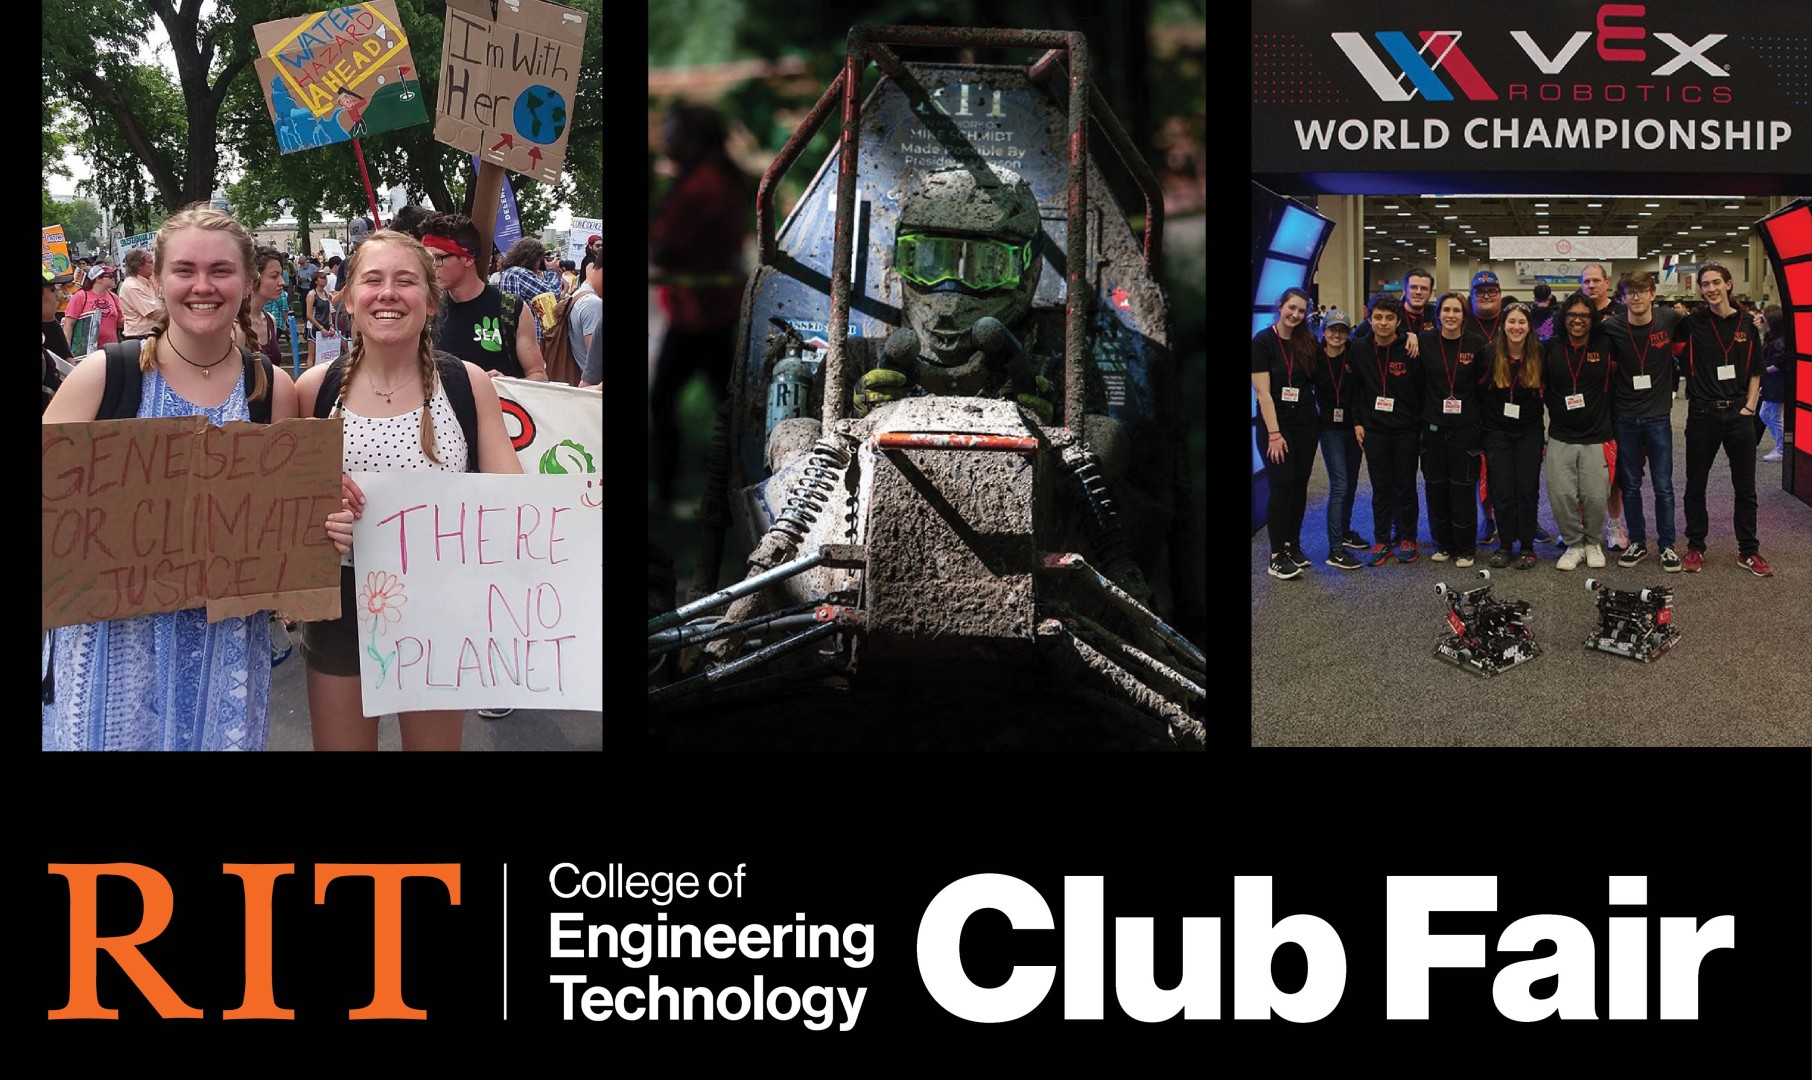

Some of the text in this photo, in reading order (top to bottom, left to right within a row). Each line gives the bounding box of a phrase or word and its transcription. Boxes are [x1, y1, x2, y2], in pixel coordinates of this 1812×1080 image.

[293, 12, 374, 88] HAZARD
[451, 10, 568, 82] I'm With
[1509, 3, 1730, 77] VEX
[447, 64, 510, 127] Her
[1509, 84, 1732, 103] ROBOTICS
[901, 142, 941, 155] Made
[1008, 146, 1026, 159] By
[1294, 117, 1792, 151] WORLD CHAMPIONSHIP
[42, 430, 298, 501] GENESEO
[132, 493, 336, 559] CLIMATE
[377, 502, 572, 575] THERE
[489, 582, 562, 637] NO
[395, 635, 577, 696] PLANET
